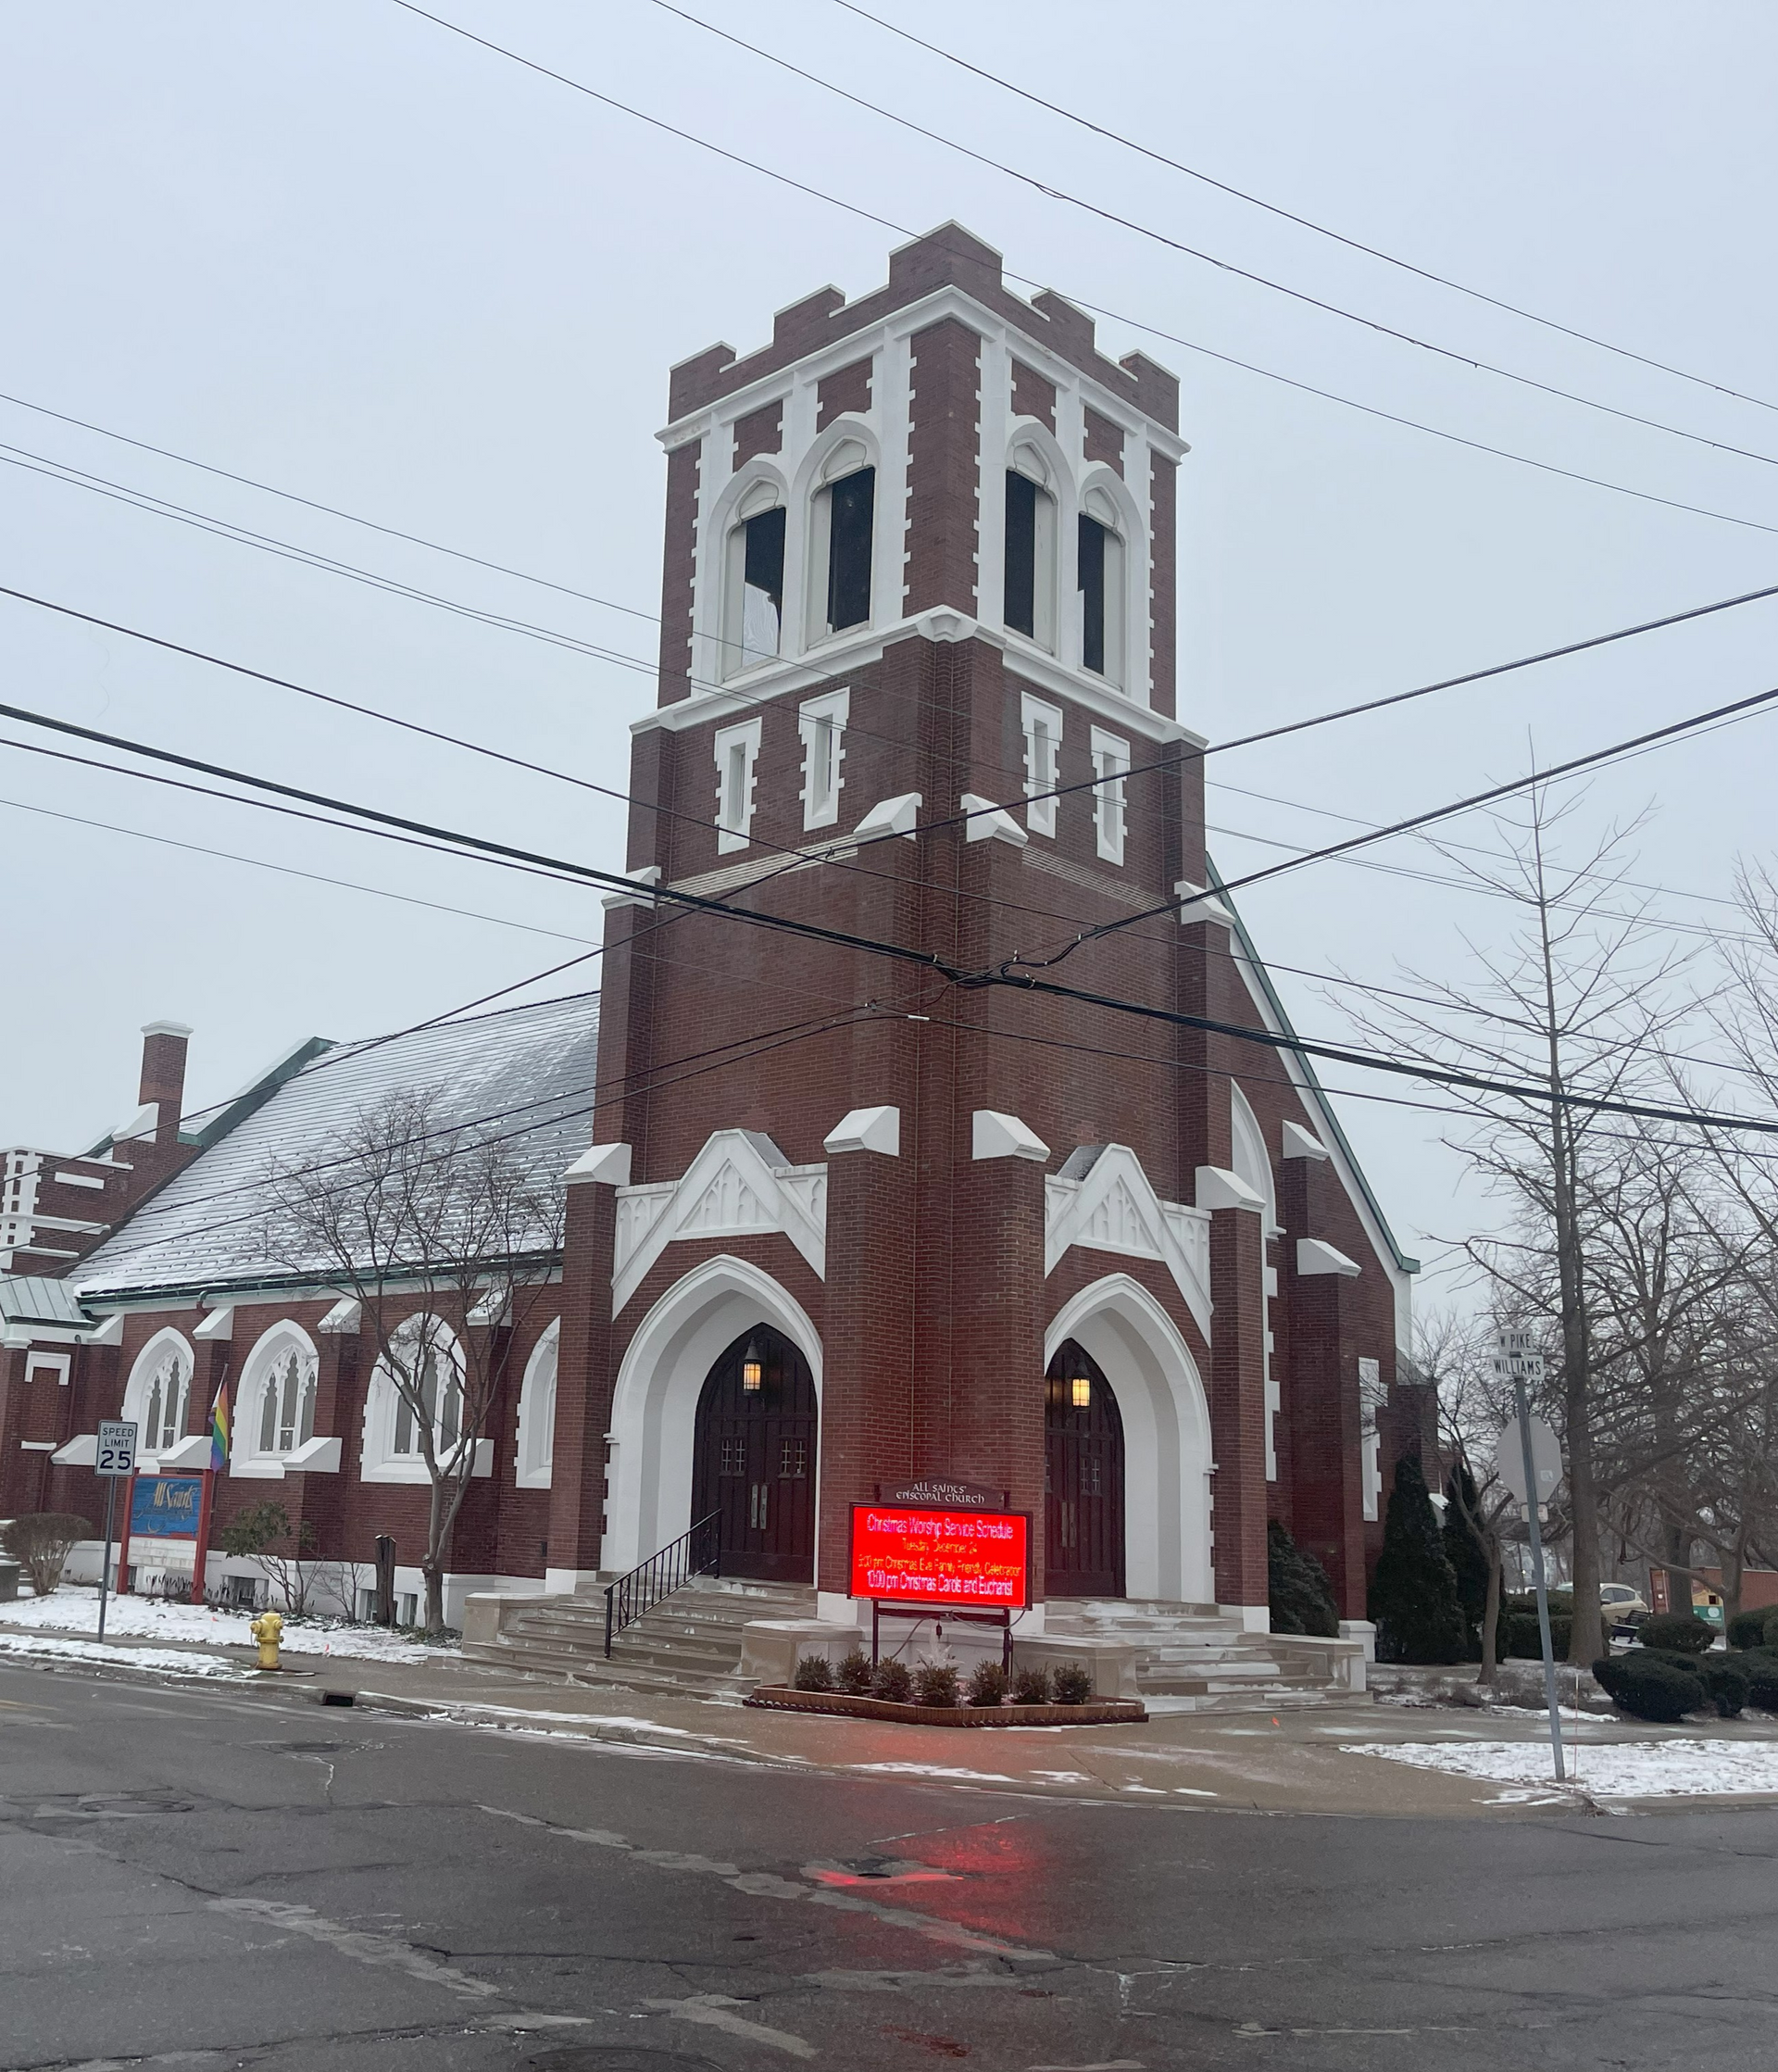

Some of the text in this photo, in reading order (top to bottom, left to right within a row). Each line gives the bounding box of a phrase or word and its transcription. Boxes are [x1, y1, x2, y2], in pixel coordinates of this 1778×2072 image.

[1510, 1334, 1531, 1349] PIKE
[1494, 1360, 1541, 1375] WILLIAMS
[102, 1427, 134, 1437] SPEED
[105, 1438, 130, 1448] LIMIT
[100, 1450, 131, 1470] 25
[867, 1513, 1013, 1539] Christmas Worship Service Schedule
[885, 1555, 917, 1571] Christmas
[886, 1575, 898, 1592] pm
[899, 1572, 936, 1591] Christmas
[938, 1574, 962, 1593] Carols
[963, 1576, 978, 1594] and
[979, 1576, 1013, 1596] Eucharist
